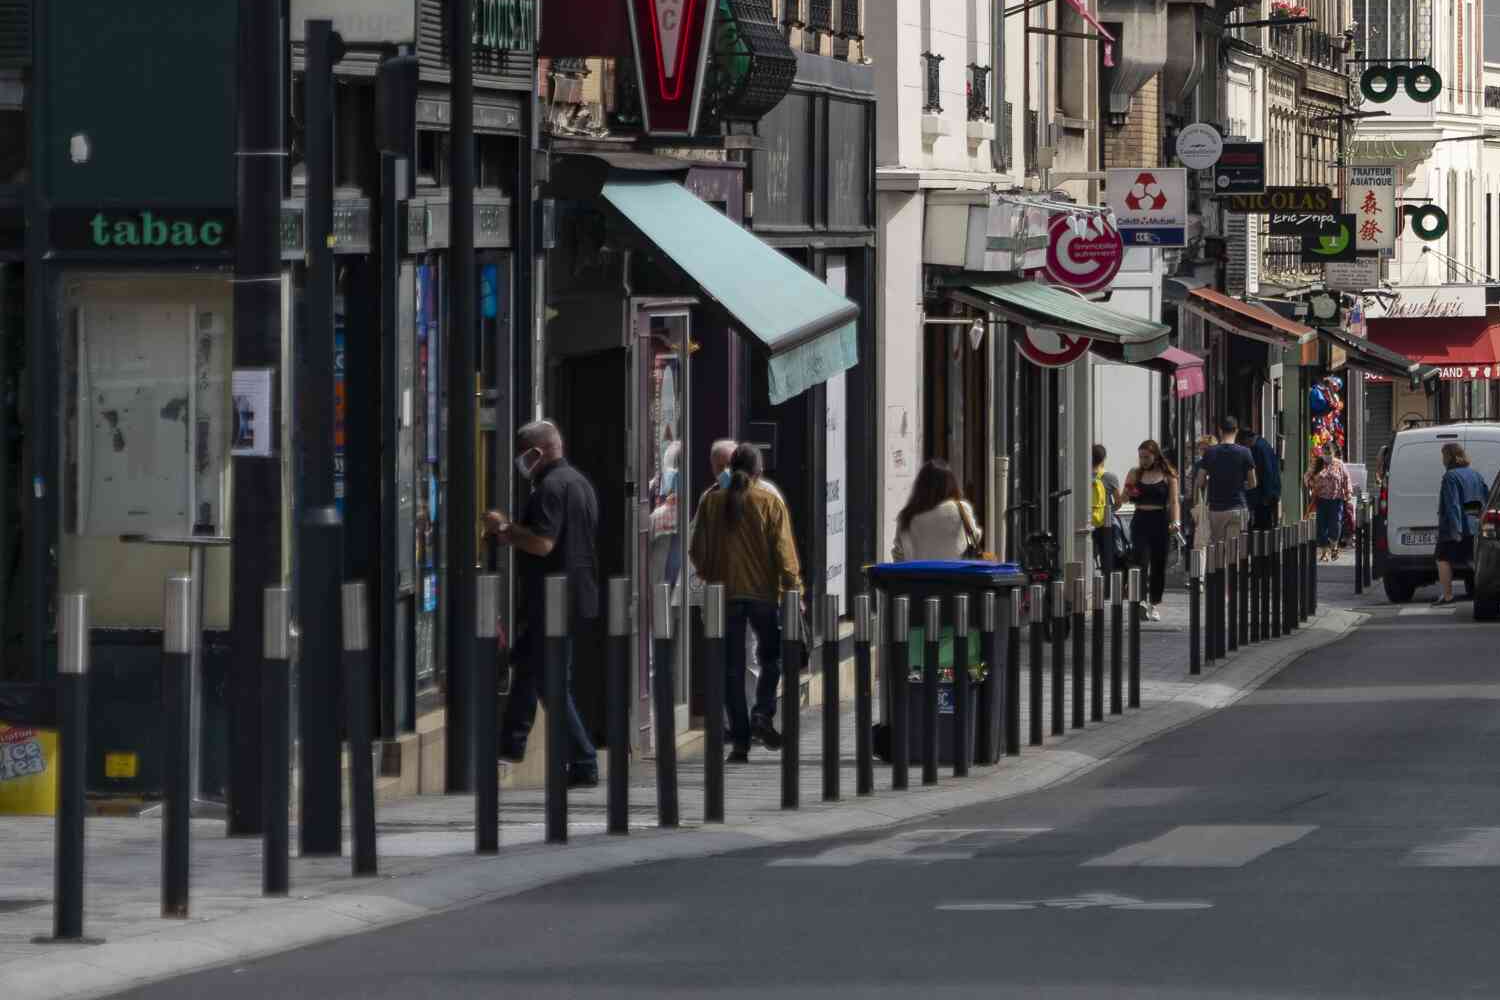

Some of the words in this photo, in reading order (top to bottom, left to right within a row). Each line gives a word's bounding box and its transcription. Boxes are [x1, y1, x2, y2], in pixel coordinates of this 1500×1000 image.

[1352, 167, 1392, 177] TRAITEUR
[1350, 177, 1393, 187] ASIATIQUE
[1232, 191, 1327, 210] NICOLAS
[90, 211, 223, 246] tabac
